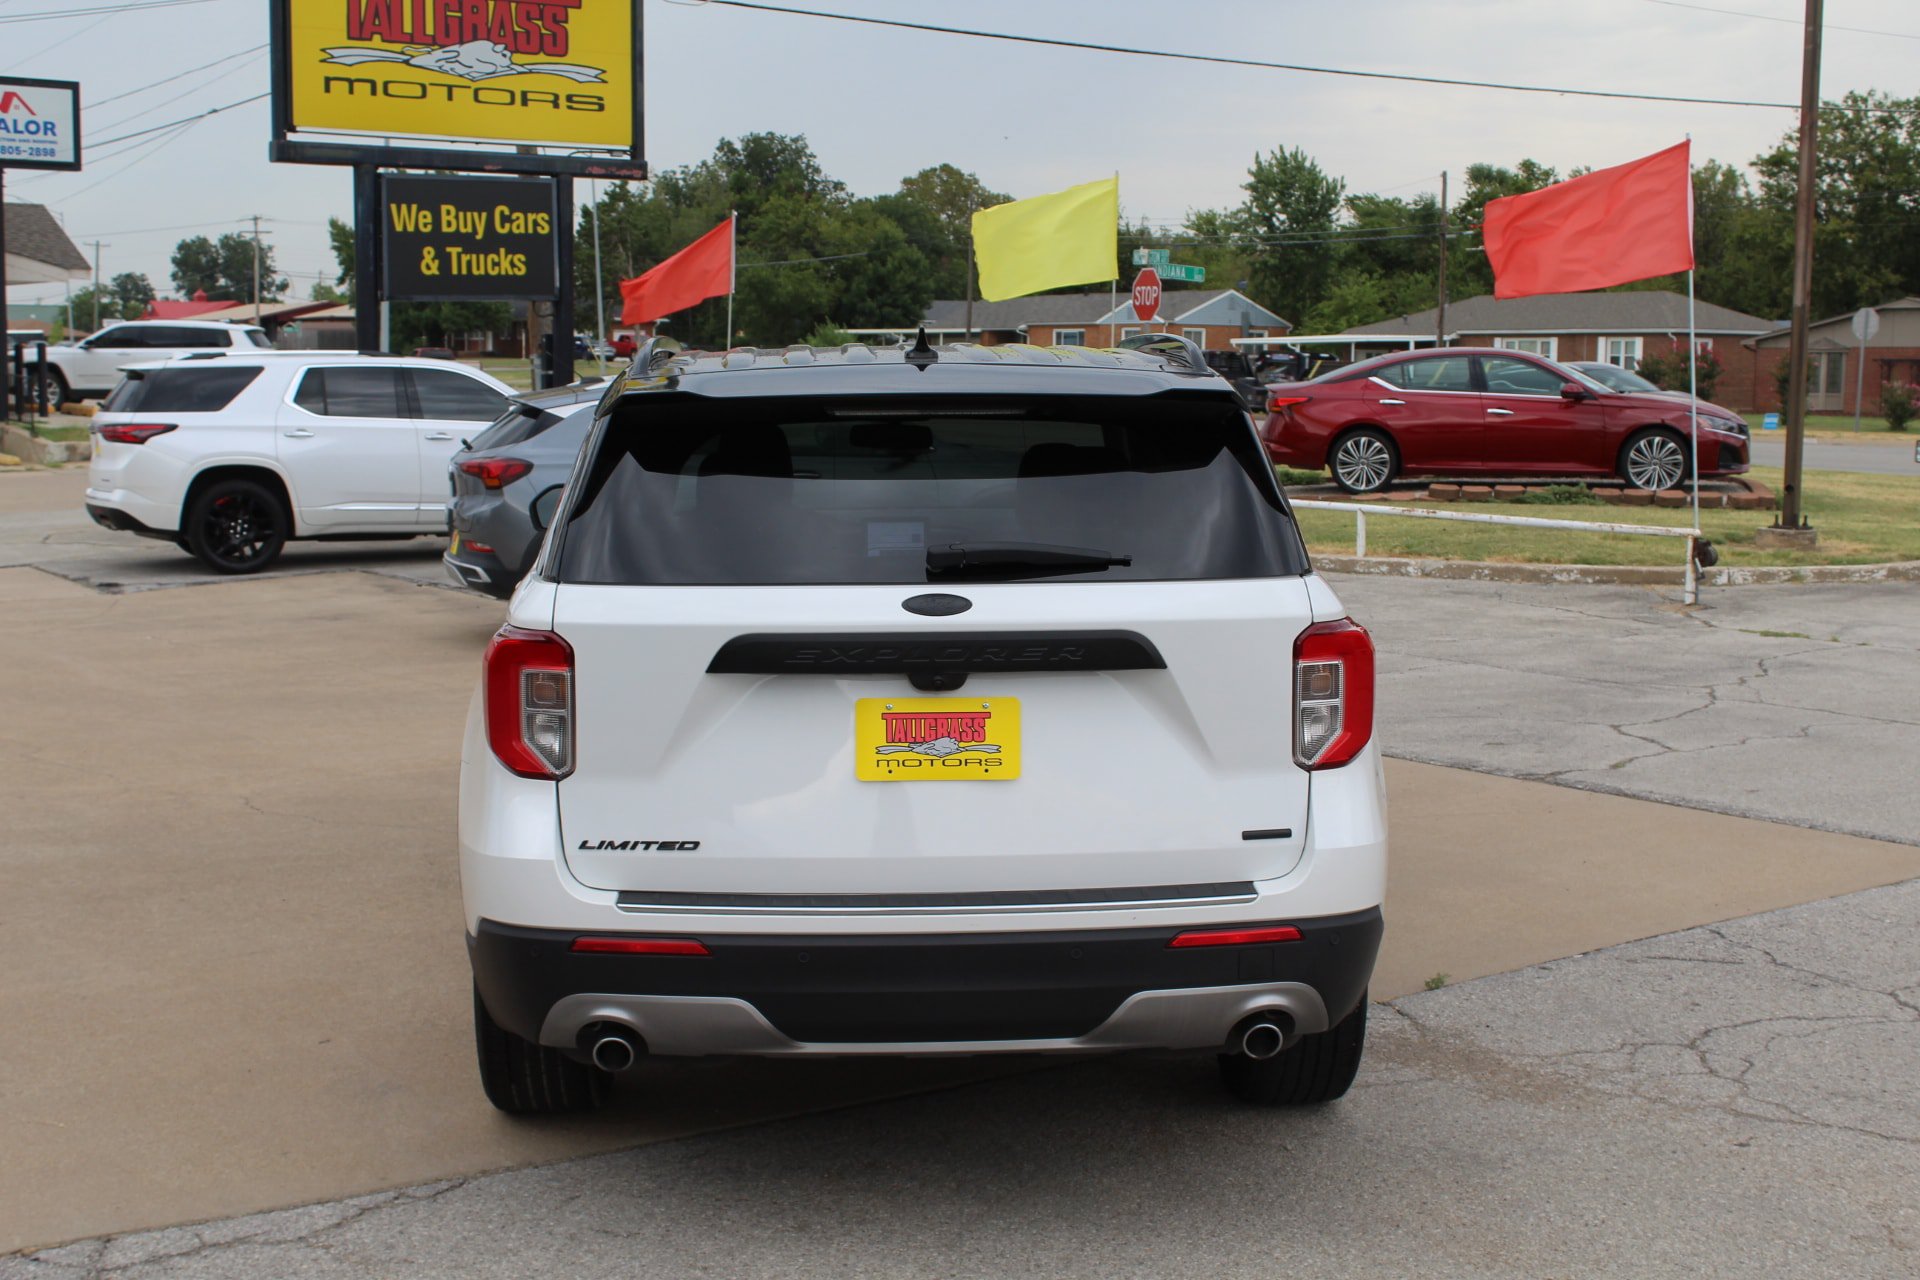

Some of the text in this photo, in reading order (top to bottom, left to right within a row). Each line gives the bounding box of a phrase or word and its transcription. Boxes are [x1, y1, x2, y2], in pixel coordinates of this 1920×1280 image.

[347, 0, 582, 57] TALLGRASS
[323, 76, 606, 112] MOTORS
[390, 203, 550, 240] We Buy Cars
[420, 246, 527, 276] & Trucks
[1134, 285, 1159, 306] STOP
[784, 645, 1086, 664] EXPLORER
[881, 711, 992, 744] TALLGRASS
[876, 758, 1003, 768] MOTORS
[578, 840, 701, 851] LIMITED
